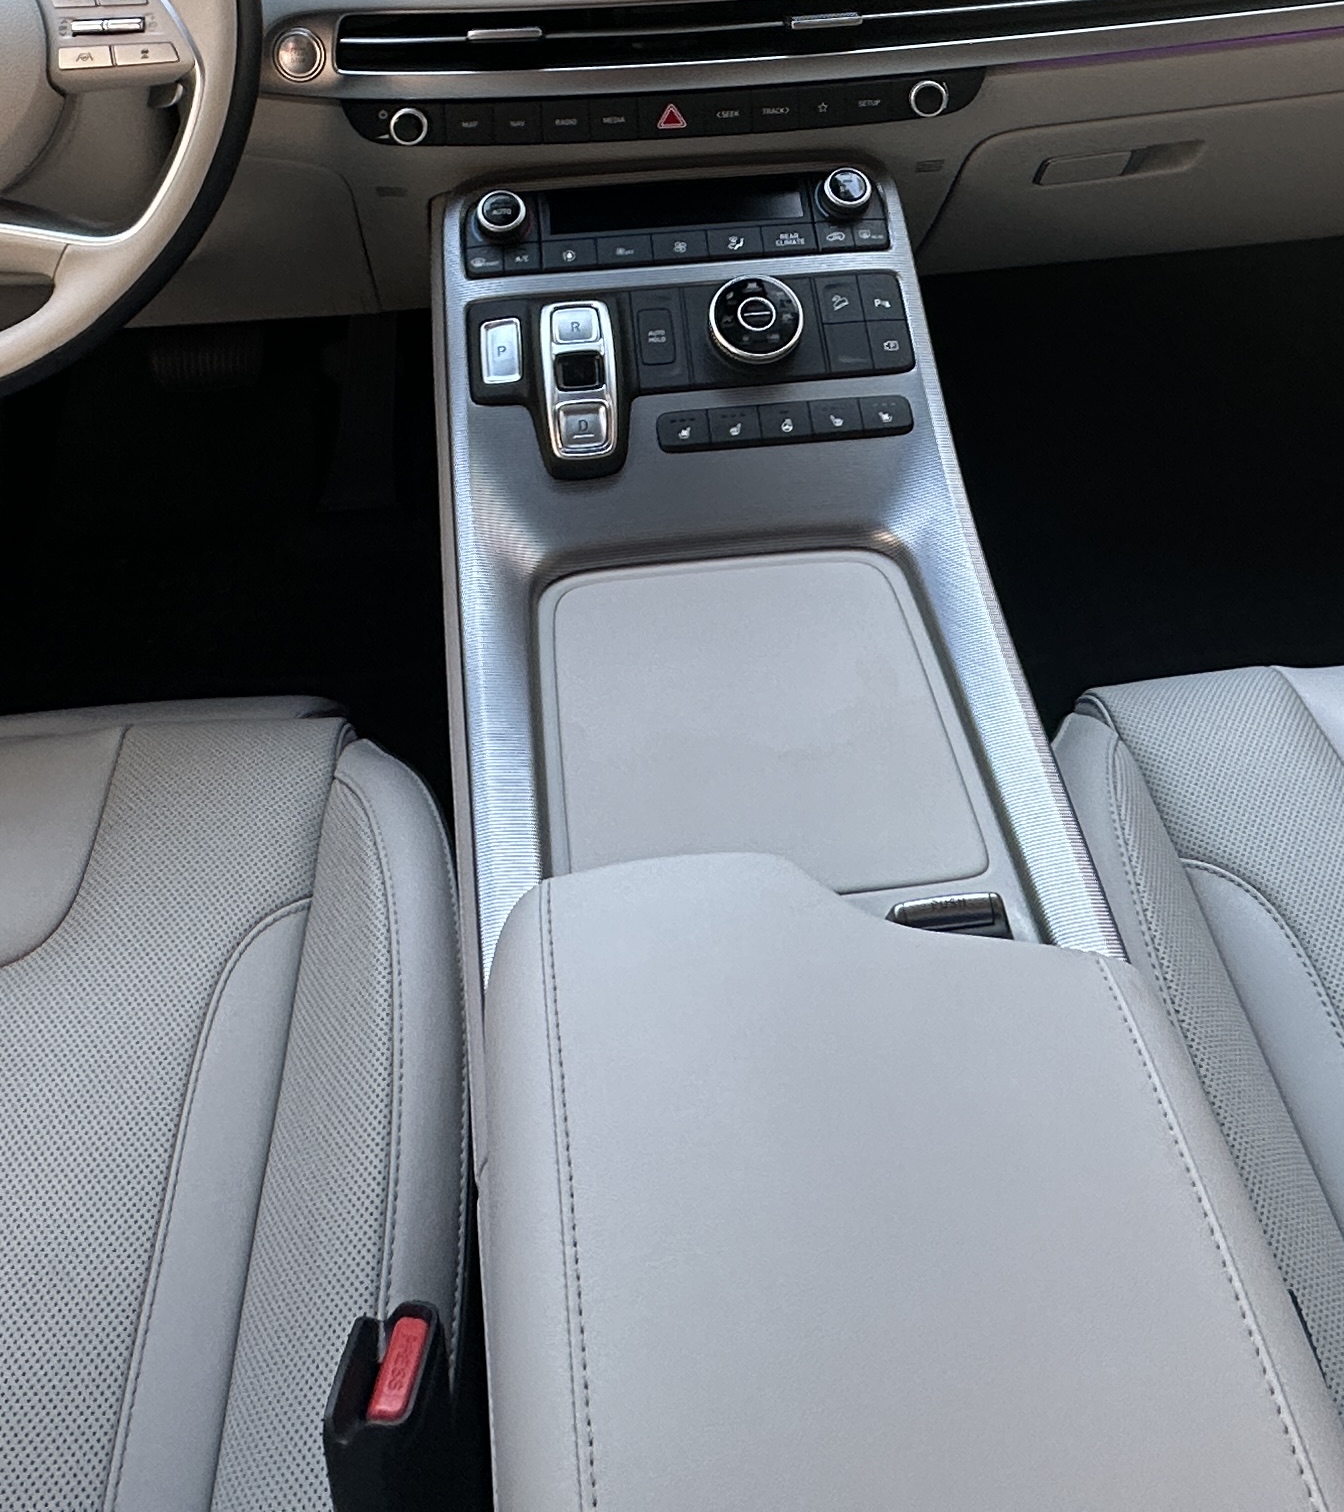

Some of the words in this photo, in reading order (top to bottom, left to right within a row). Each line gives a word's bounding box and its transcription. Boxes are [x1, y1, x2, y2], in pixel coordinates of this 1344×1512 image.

[858, 99, 882, 108] SETUP
[555, 118, 578, 126] RADIO
[602, 116, 626, 124] MEDIA
[491, 207, 512, 216] AUTO
[775, 238, 805, 246] CLIMATE
[570, 321, 581, 332] R
[497, 345, 507, 357] P
[577, 419, 589, 432] D
[387, 1333, 419, 1391] PRESS
